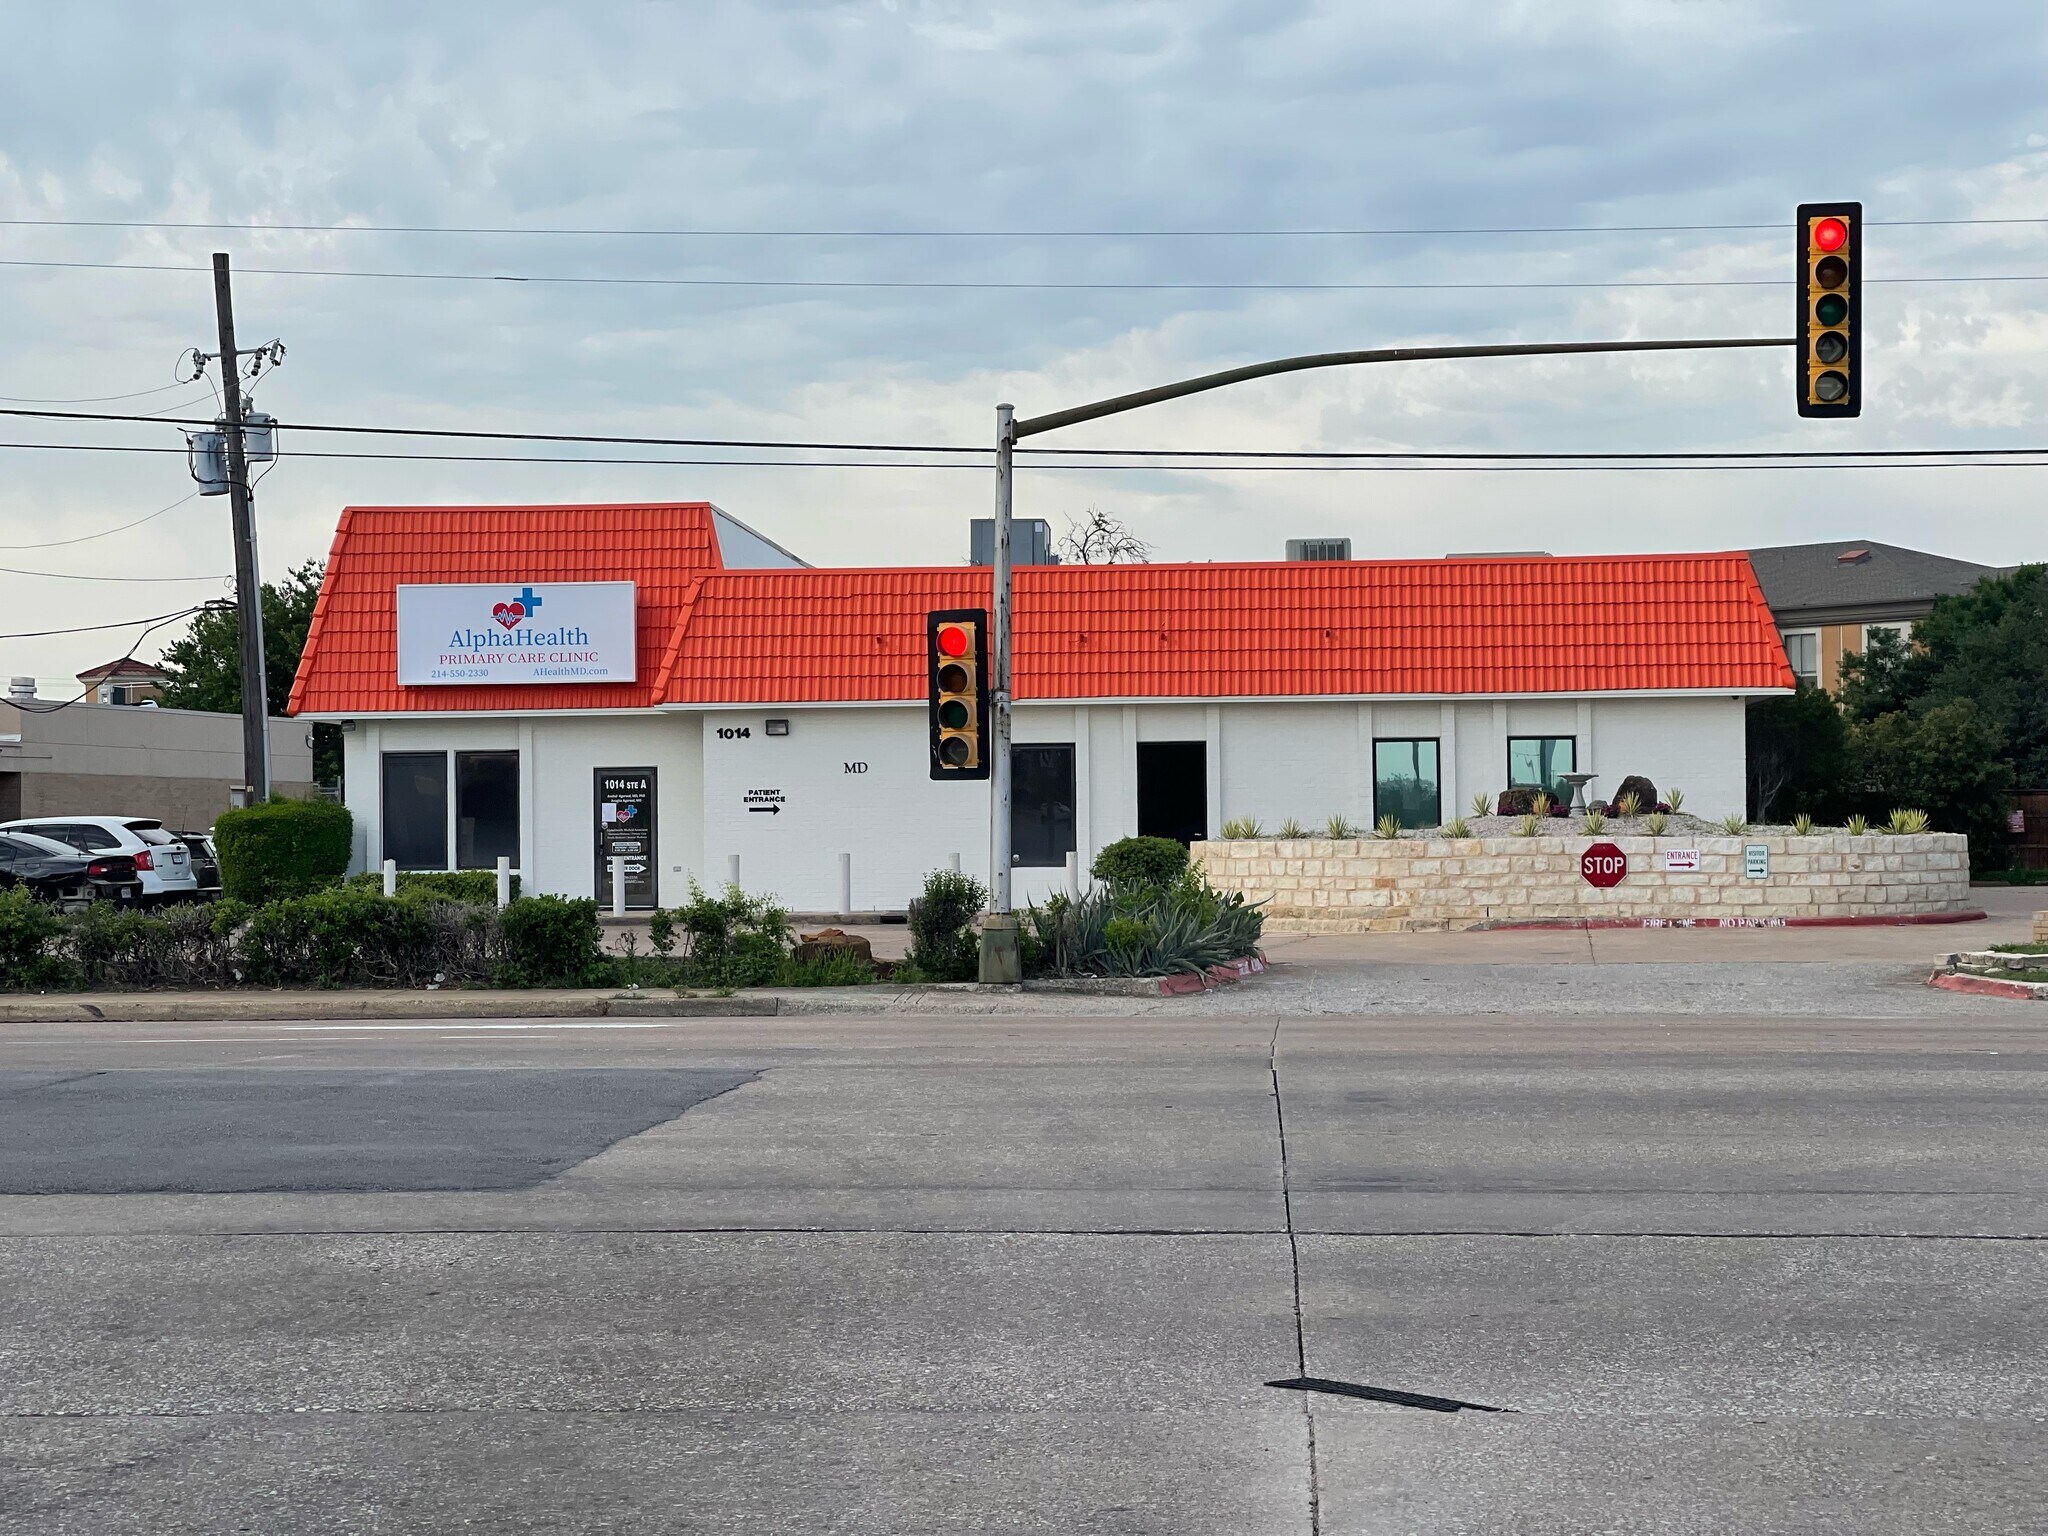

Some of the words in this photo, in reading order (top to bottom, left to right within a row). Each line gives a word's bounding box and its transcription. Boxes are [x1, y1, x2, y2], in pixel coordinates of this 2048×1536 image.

[449, 627, 589, 652] AlphaHealth
[439, 653, 505, 665] PRIMARY
[507, 652, 546, 664] CARE
[549, 651, 599, 663] CLINIC
[431, 668, 489, 678] 214-550-2330
[533, 667, 609, 677] AHealthMD.com
[716, 728, 751, 740] 1014
[843, 761, 869, 774] MD
[604, 779, 625, 790] 1014
[626, 781, 639, 790] STE
[640, 779, 647, 789] A
[1666, 851, 1698, 860] ENTRANCE
[1583, 857, 1625, 875] STOP
[1719, 918, 1736, 928] NO
